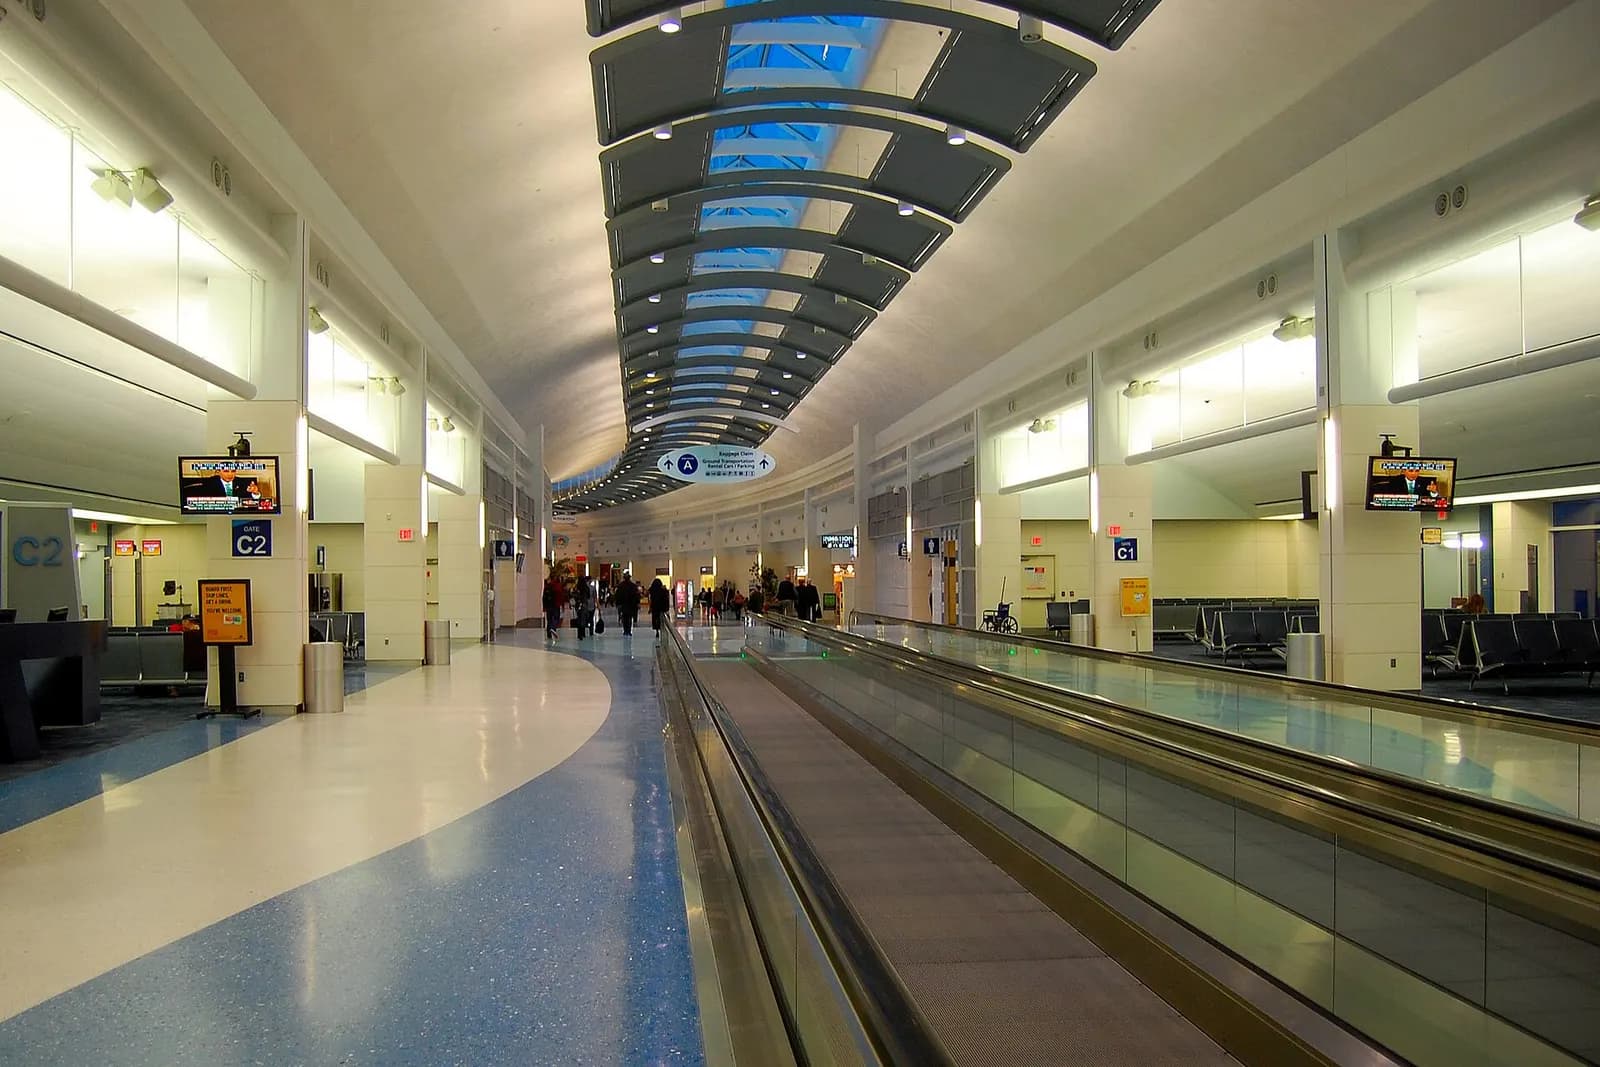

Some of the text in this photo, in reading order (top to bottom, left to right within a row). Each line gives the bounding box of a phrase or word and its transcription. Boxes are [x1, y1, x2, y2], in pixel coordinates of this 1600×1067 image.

[683, 460, 692, 470] A
[399, 529, 411, 539] EXIT
[13, 536, 63, 566] C2
[236, 535, 266, 554] C2
[1117, 547, 1134, 560] C1
